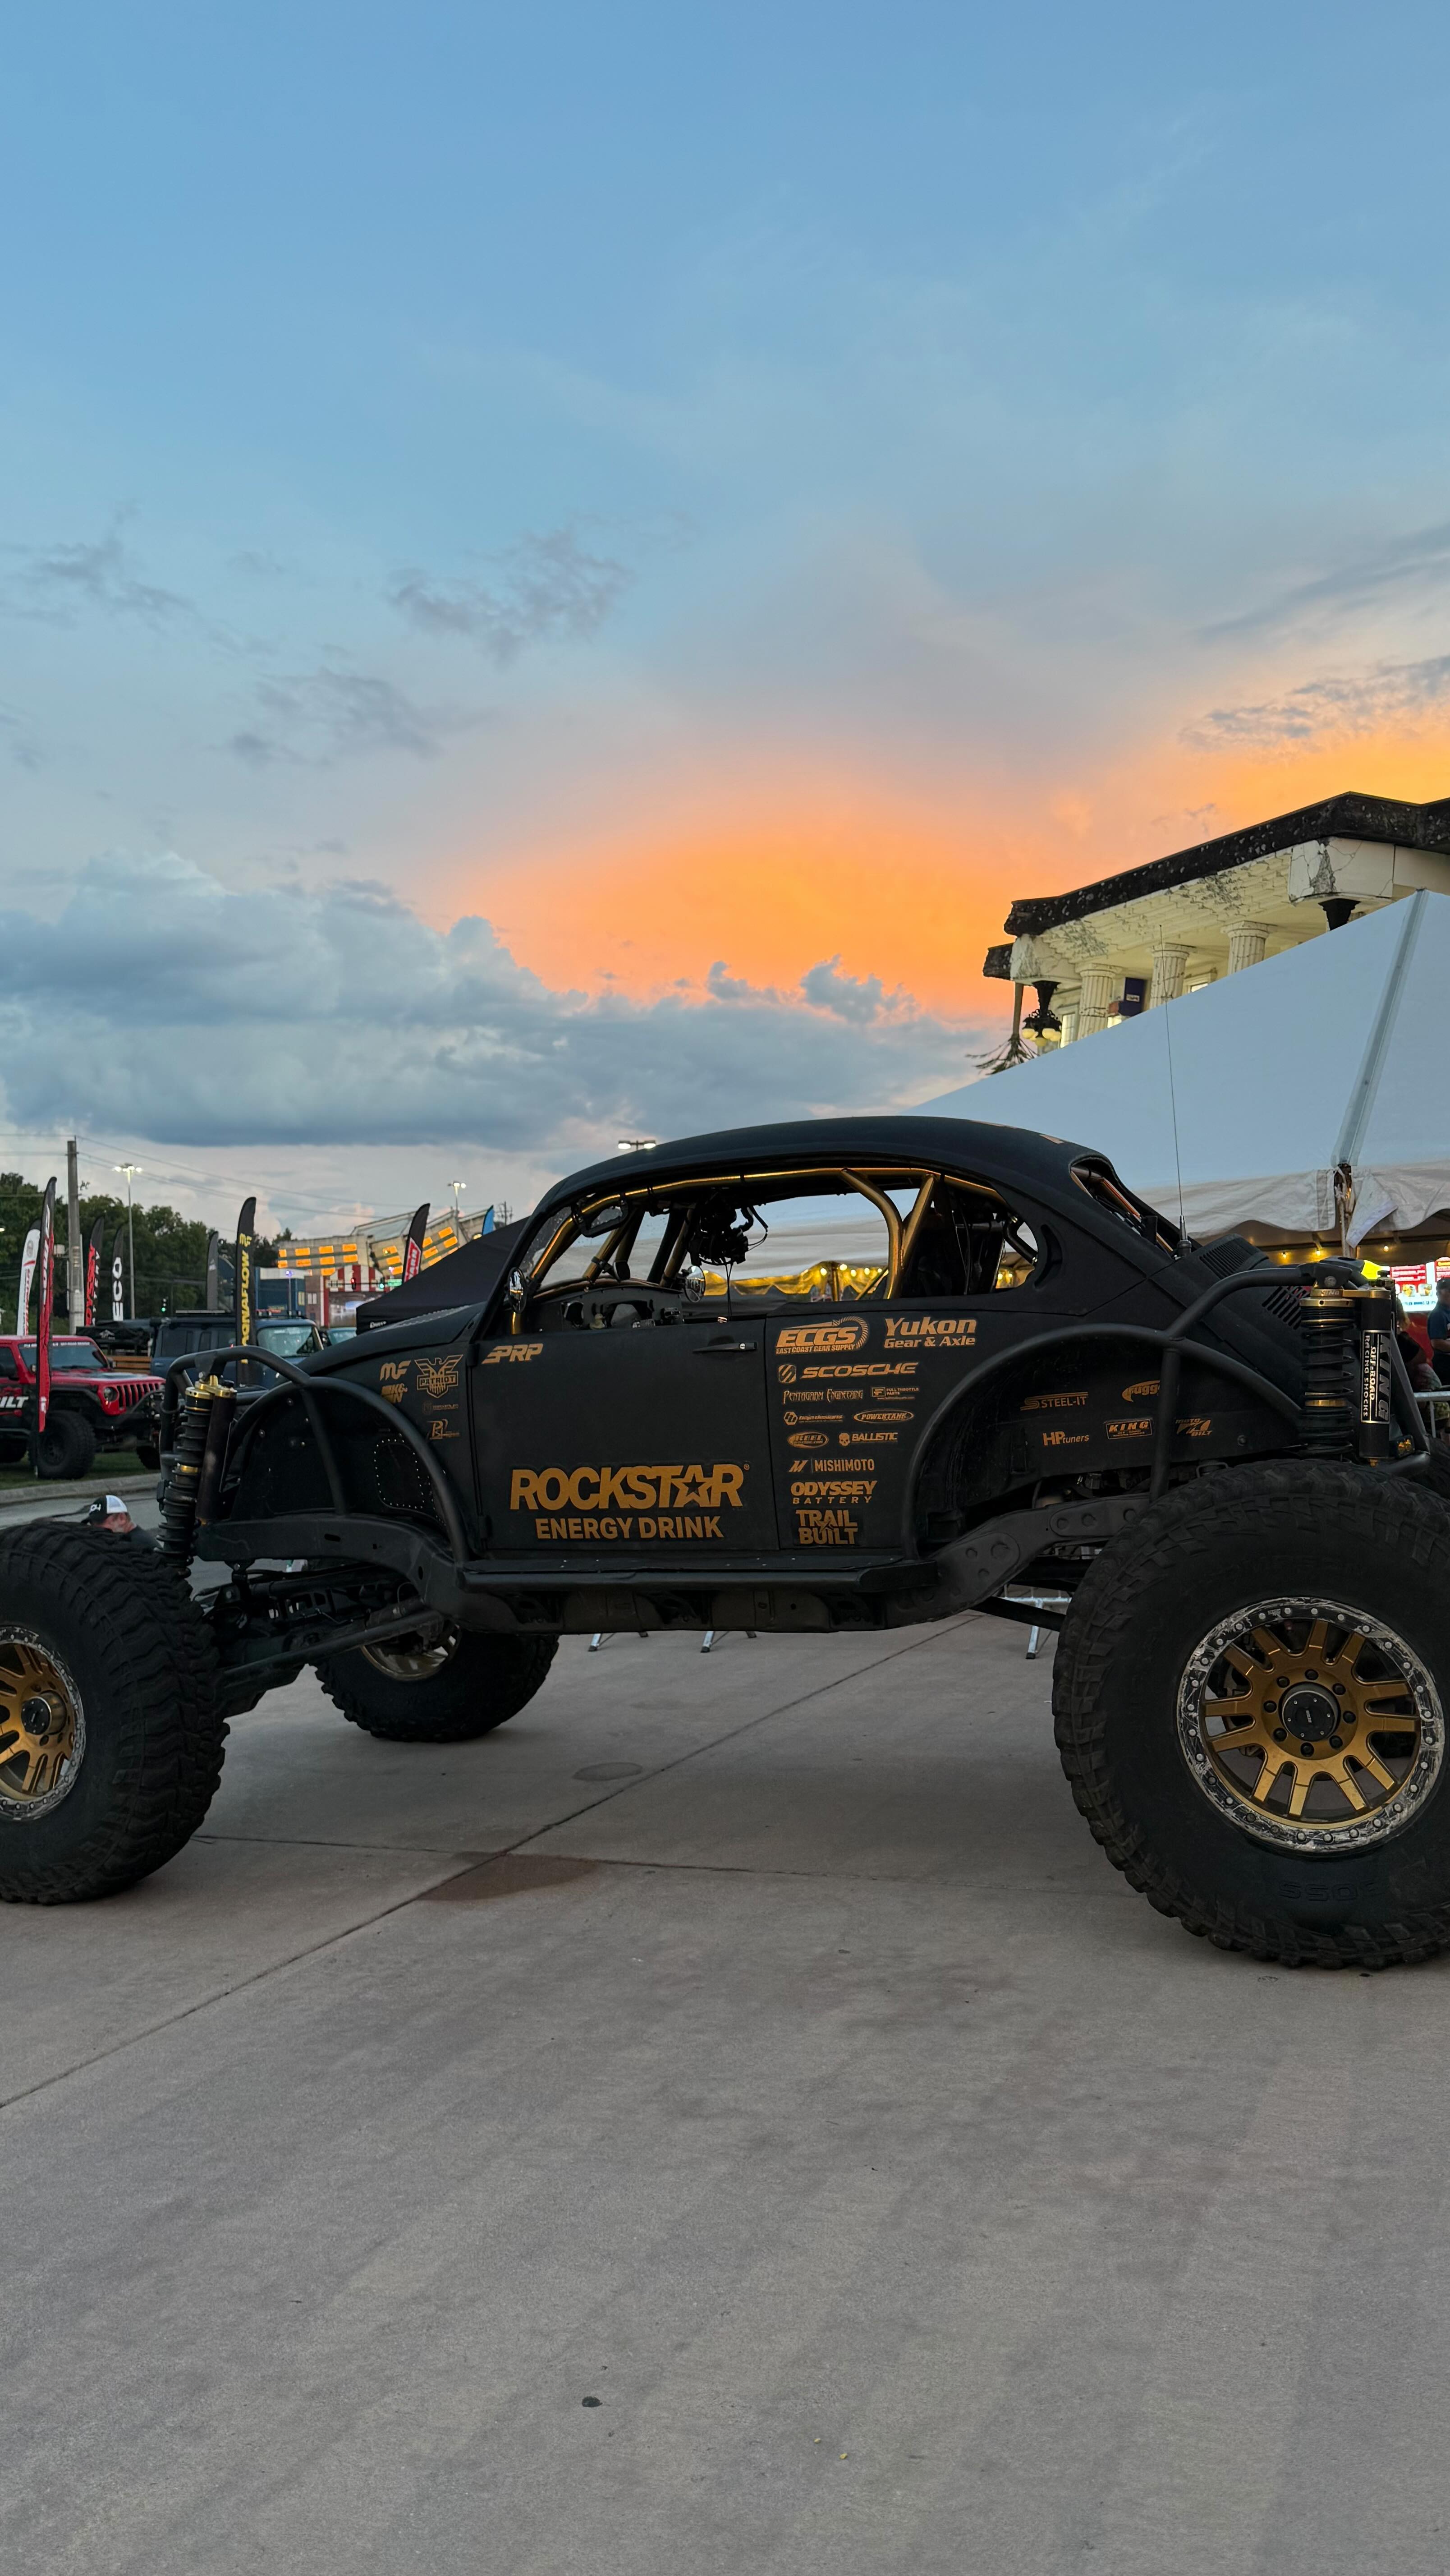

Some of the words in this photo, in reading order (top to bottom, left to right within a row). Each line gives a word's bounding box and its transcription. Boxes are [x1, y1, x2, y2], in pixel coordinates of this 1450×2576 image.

[92, 1250, 101, 1326] ATTERY
[240, 1250, 250, 1364] AGNAFLOW
[885, 1316, 977, 1336] Yukon
[777, 1327, 858, 1348] ECGS
[884, 1338, 922, 1348] Gear
[924, 1337, 936, 1346] &
[939, 1335, 976, 1347] Axle
[482, 1343, 544, 1364] PRP
[800, 1362, 919, 1379] SCOSCHE
[1378, 1334, 1390, 1420] KING
[420, 1376, 455, 1386] PATRIOT
[1128, 1384, 1160, 1396] rugg
[0, 1396, 29, 1408] ILT
[1041, 1396, 1087, 1408] STEEL-IT
[1109, 1421, 1148, 1432] KING
[852, 1432, 898, 1441] BALLISTIC
[814, 1459, 875, 1472] MISHIMOTO
[790, 1480, 878, 1496] ODYSSEY
[793, 1496, 872, 1504] BATTERY
[795, 1509, 858, 1527] TRAIL
[535, 1517, 633, 1539] ENERGY
[638, 1516, 724, 1539] DRINK
[798, 1527, 858, 1545] BUILT
